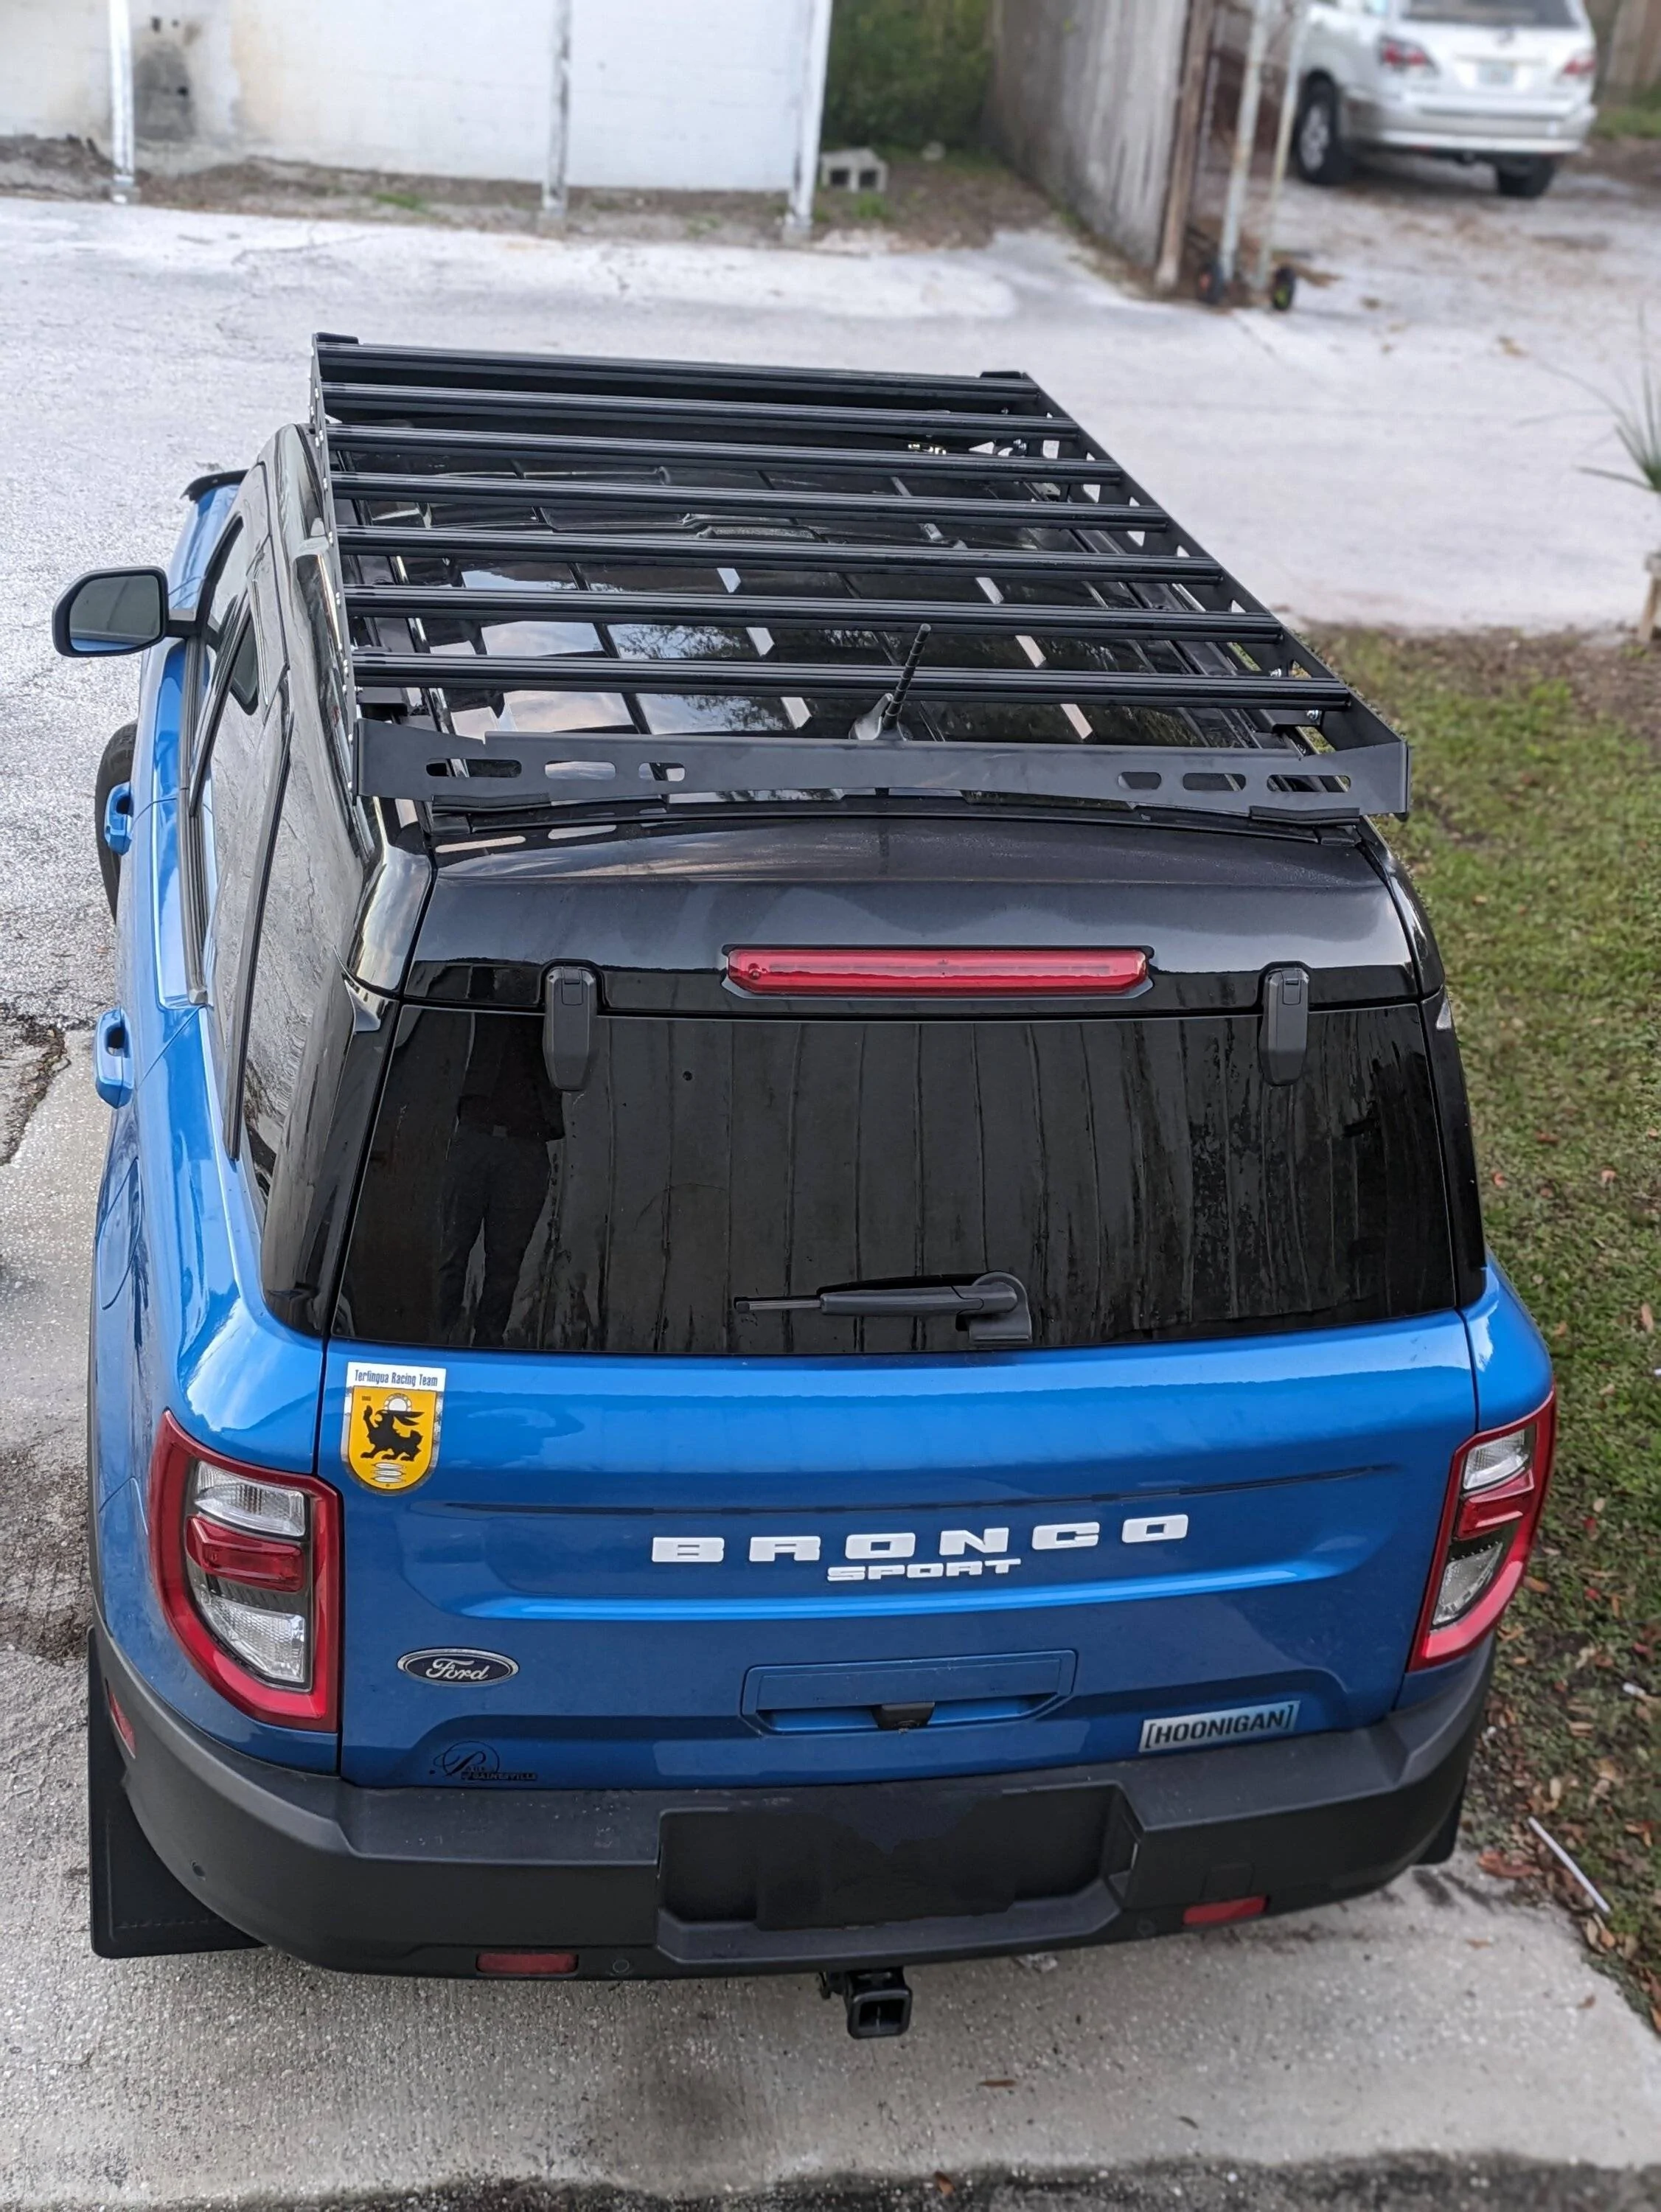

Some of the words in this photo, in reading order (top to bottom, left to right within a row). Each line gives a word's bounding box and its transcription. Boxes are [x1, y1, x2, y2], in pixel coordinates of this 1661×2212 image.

[355, 1369, 389, 1384] Terlingua
[391, 1372, 417, 1387] Racing
[419, 1374, 438, 1386] Team
[652, 1514, 1189, 1562] BRONCO
[827, 1558, 1022, 1582] SPORT
[425, 1658, 490, 1680] Ford
